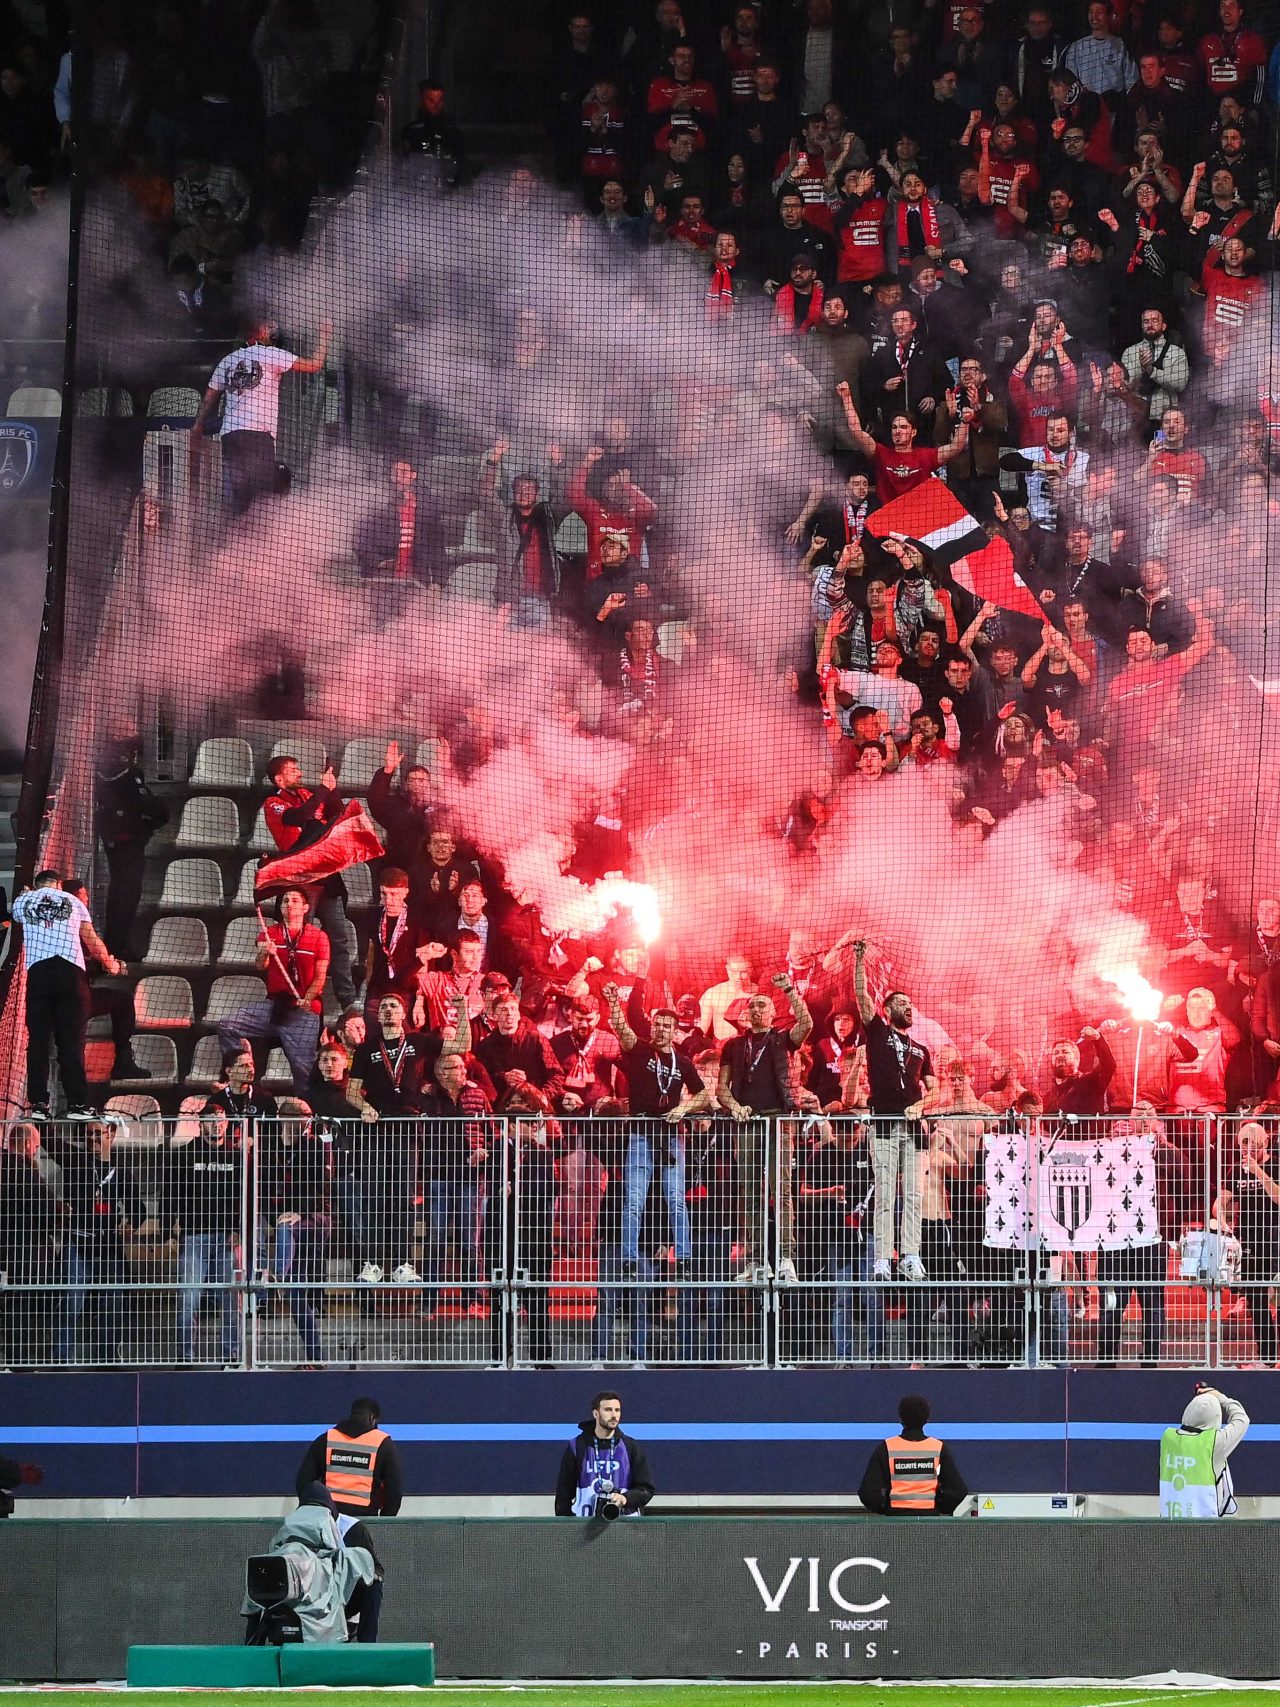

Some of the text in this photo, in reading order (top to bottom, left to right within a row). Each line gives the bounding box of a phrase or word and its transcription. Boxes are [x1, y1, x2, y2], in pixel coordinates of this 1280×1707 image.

[586, 1460, 620, 1474] LFP
[1165, 1454, 1197, 1470] LFP
[743, 1557, 891, 1613] VIC
[829, 1619, 889, 1631] TRANSPORT
